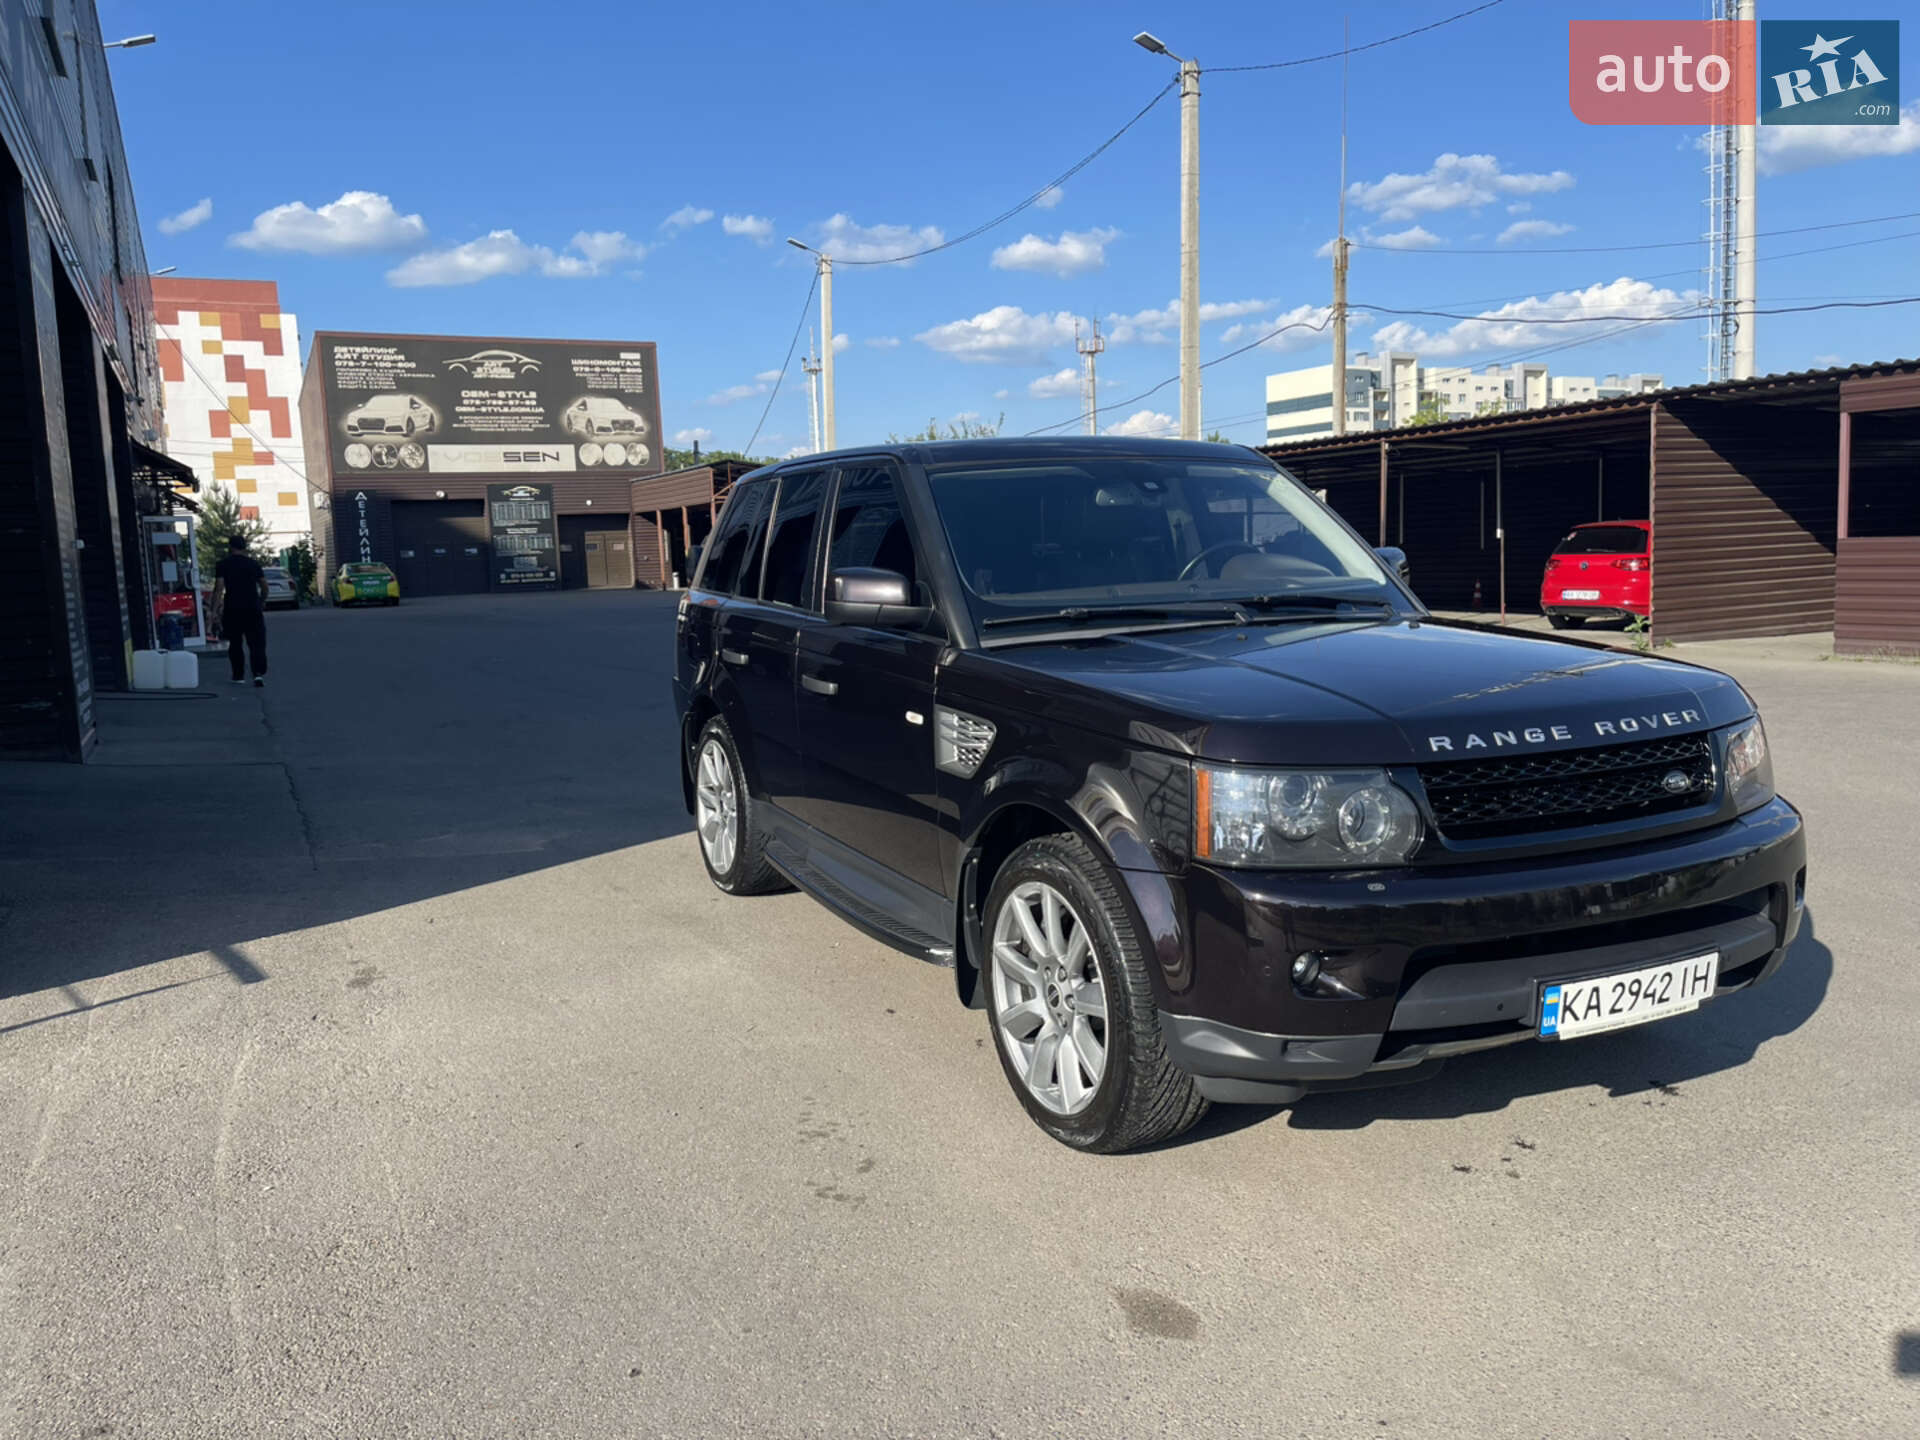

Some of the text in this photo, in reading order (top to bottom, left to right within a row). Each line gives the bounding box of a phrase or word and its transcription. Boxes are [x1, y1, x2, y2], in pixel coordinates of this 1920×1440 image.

[461, 390, 537, 398] OEM-STYLE
[1429, 709, 1701, 752] RANGE ROVER
[1561, 986, 1602, 1025] KA
[1608, 971, 1673, 1015] 2942
[1681, 961, 1712, 999] IH
[1543, 1016, 1557, 1027] UA
